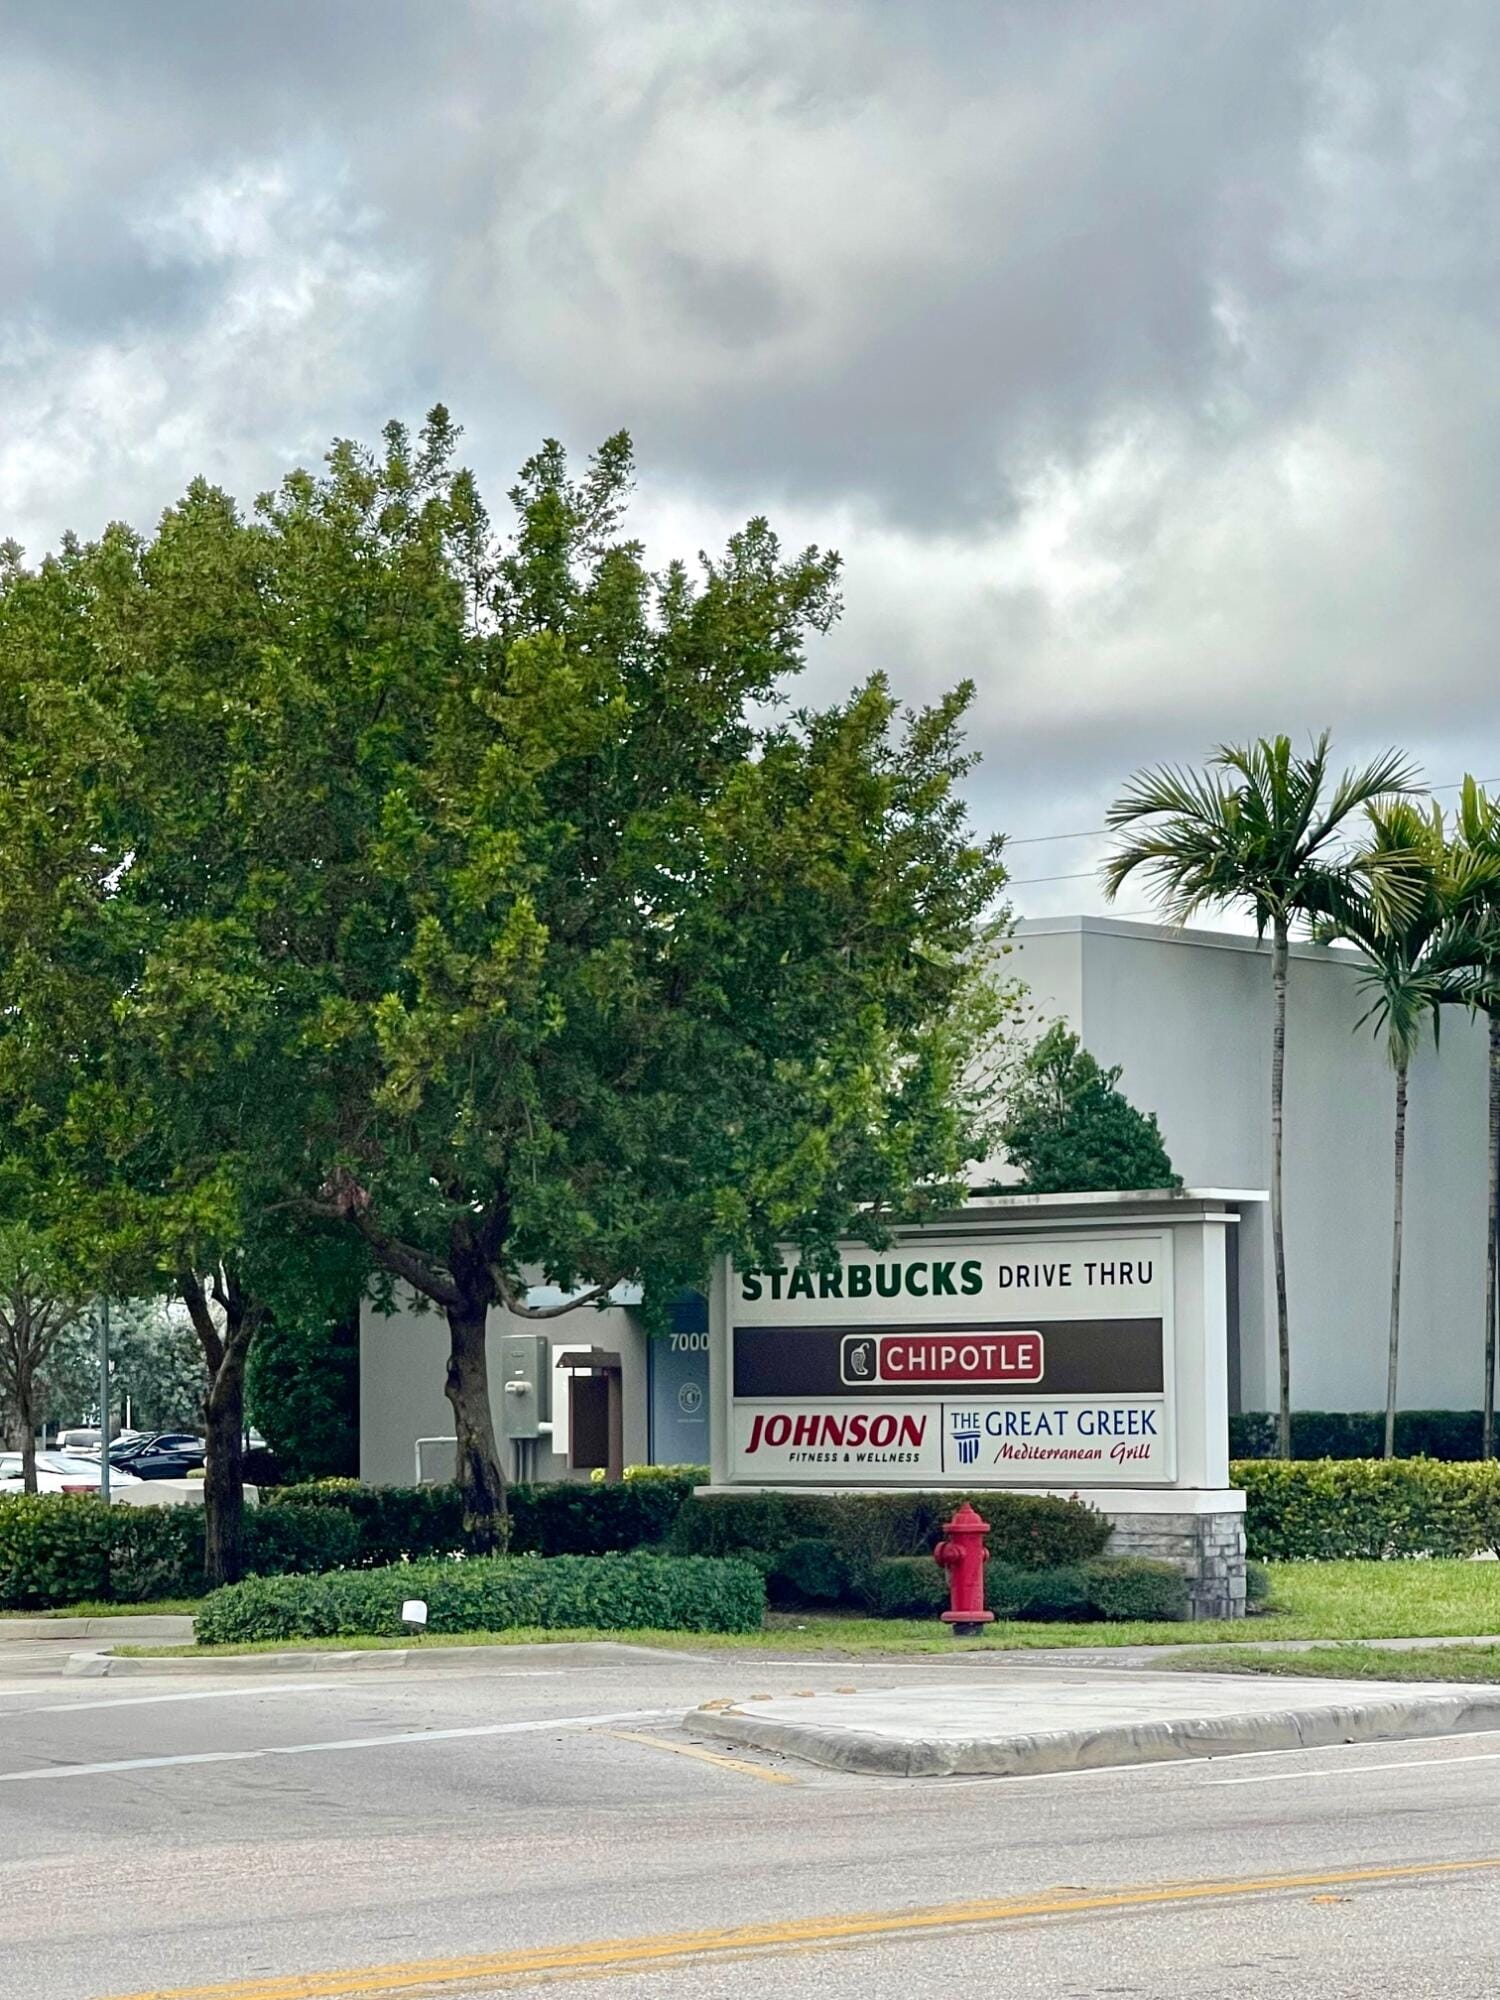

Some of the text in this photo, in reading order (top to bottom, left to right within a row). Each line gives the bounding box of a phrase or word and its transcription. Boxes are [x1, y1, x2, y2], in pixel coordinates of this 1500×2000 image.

[742, 1260, 1153, 1301] STARBUCKS DRIVE THRU
[669, 1332, 709, 1352] 7000
[886, 1344, 1034, 1372] CHIPOTLE
[745, 1414, 927, 1454] JOHNSON
[950, 1410, 1158, 1436] THE GREAT GREEK
[789, 1452, 838, 1463] FITNESS
[856, 1452, 920, 1463] WELLNESS
[993, 1441, 1151, 1464] Mediterranean Grill
